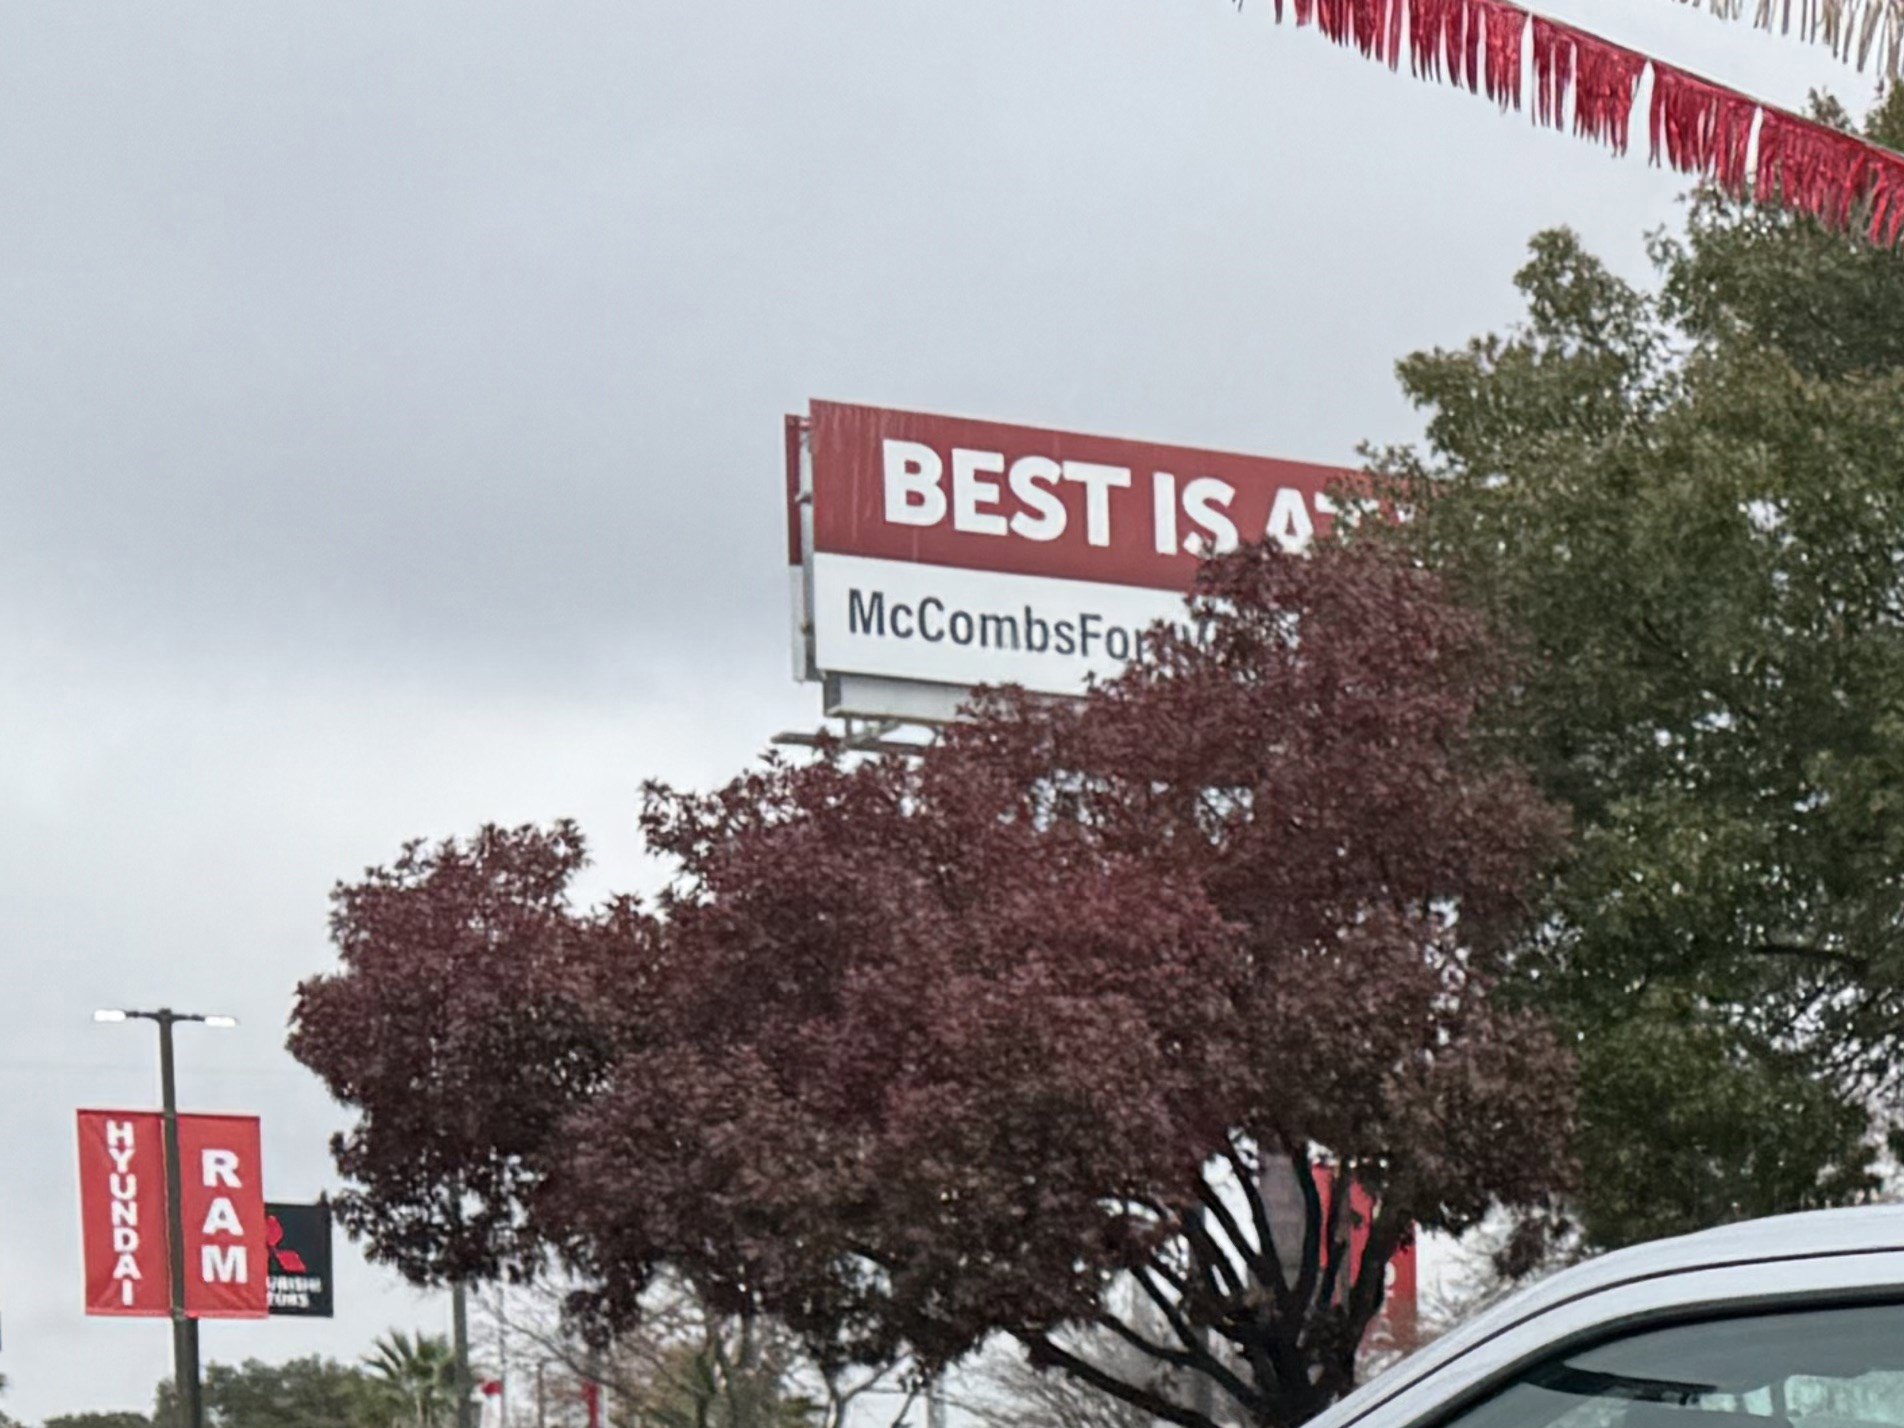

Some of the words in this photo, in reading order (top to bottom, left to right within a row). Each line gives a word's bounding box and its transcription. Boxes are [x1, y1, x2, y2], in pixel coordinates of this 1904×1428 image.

[882, 438, 1132, 548] BEST
[1152, 470, 1239, 560] IS
[848, 588, 1160, 665] McCombsFor
[106, 1119, 142, 1306] HYUNDAI
[201, 1148, 248, 1284] RAM
